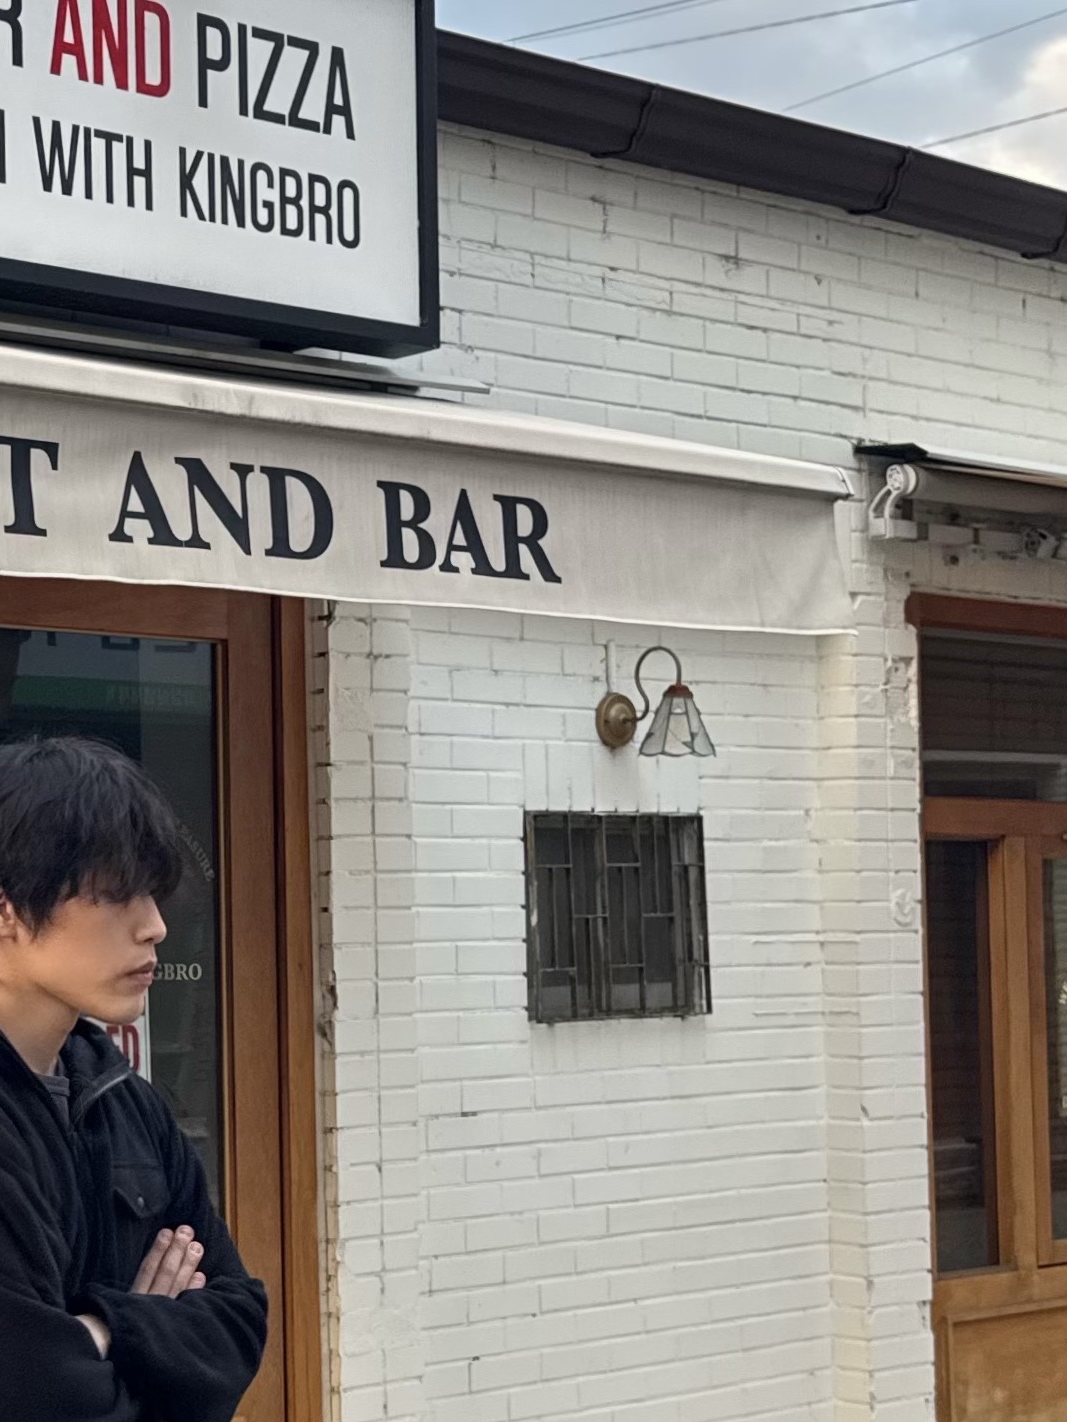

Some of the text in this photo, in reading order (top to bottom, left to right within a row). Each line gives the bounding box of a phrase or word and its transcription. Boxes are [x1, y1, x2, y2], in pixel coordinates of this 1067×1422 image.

[49, 0, 171, 98] AND
[196, 12, 355, 141] PIZZA
[33, 115, 153, 212] WITH
[178, 146, 361, 250] KINGBRO
[108, 450, 335, 560] AND
[376, 479, 563, 585] BAR
